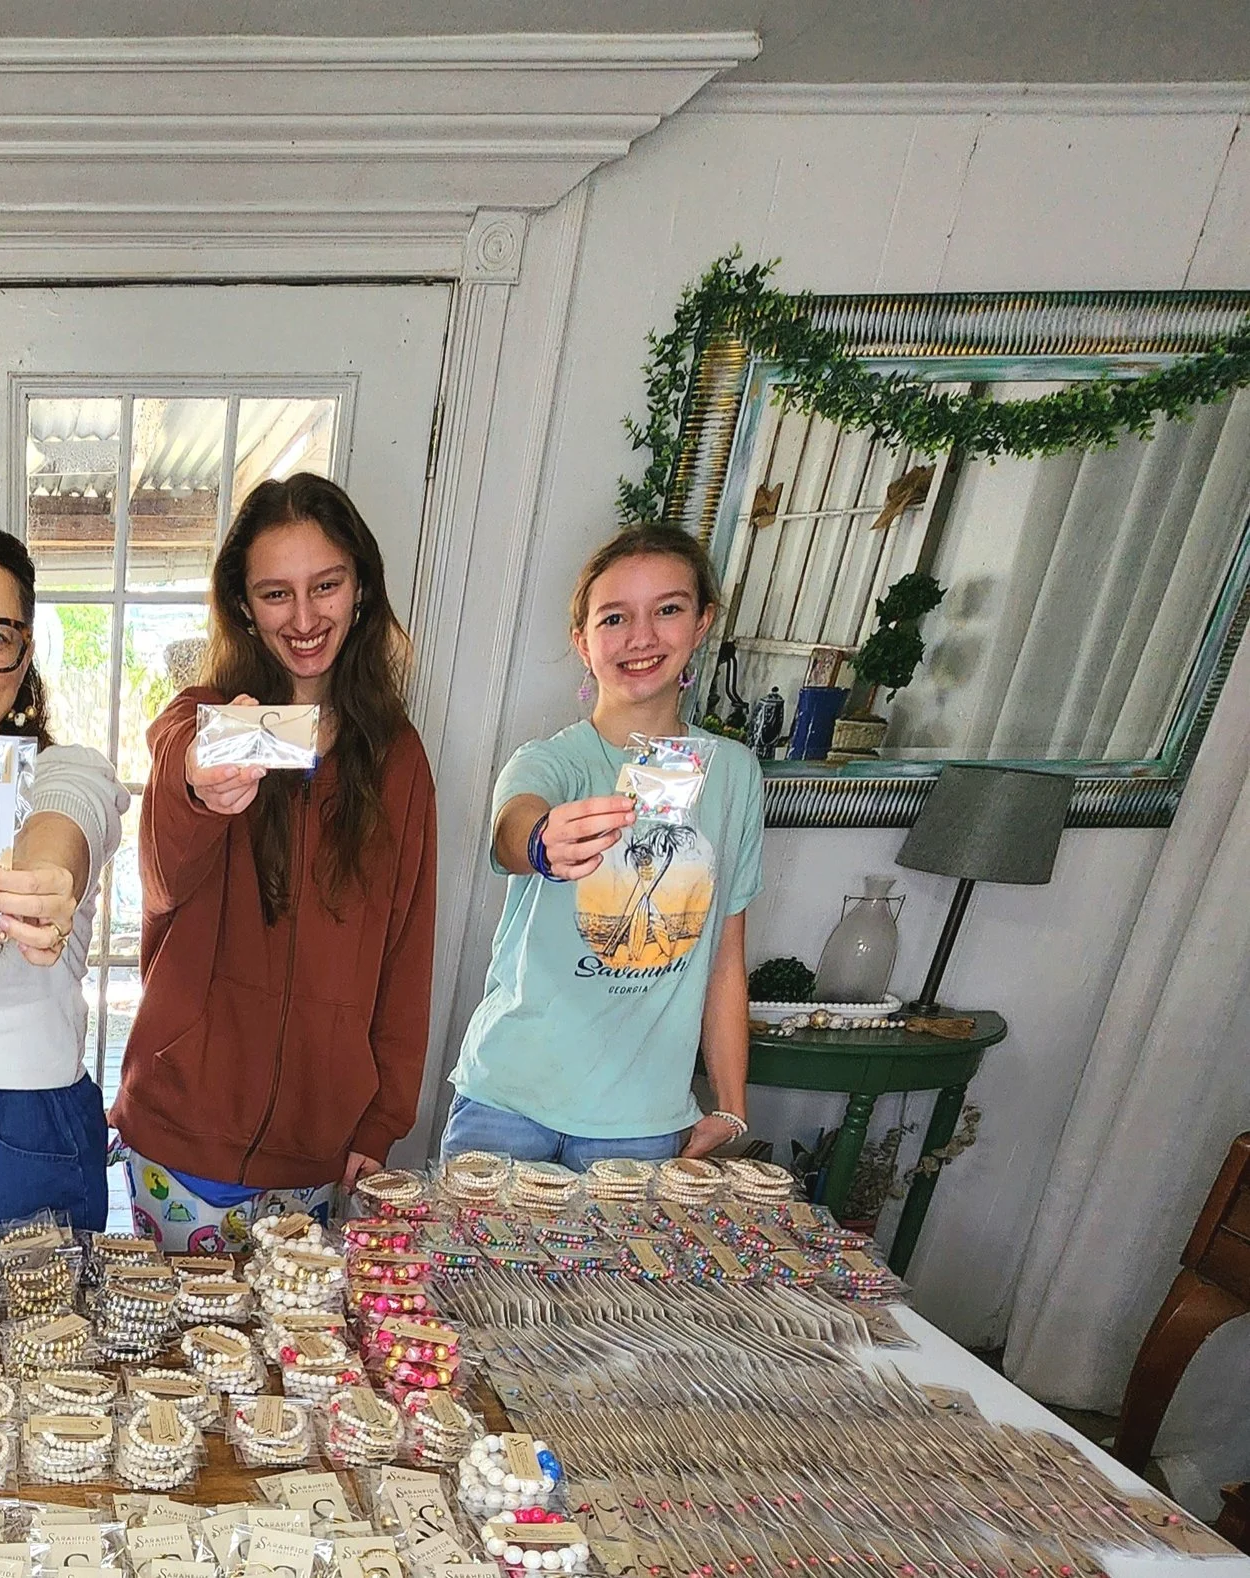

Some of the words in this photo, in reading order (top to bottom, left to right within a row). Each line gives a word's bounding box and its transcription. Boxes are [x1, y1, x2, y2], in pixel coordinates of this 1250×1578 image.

[574, 954, 687, 980] Savannah
[608, 984, 649, 995] GEORGIA
[290, 1482, 334, 1494] SARAHFIDE
[396, 1486, 439, 1499] SARAHFIDE
[153, 1505, 198, 1521] SARAHFID
[46, 1533, 95, 1545] SARAHFIDE
[135, 1536, 183, 1549] SARAHFIDE
[255, 1536, 309, 1555] SARAHFIDE
